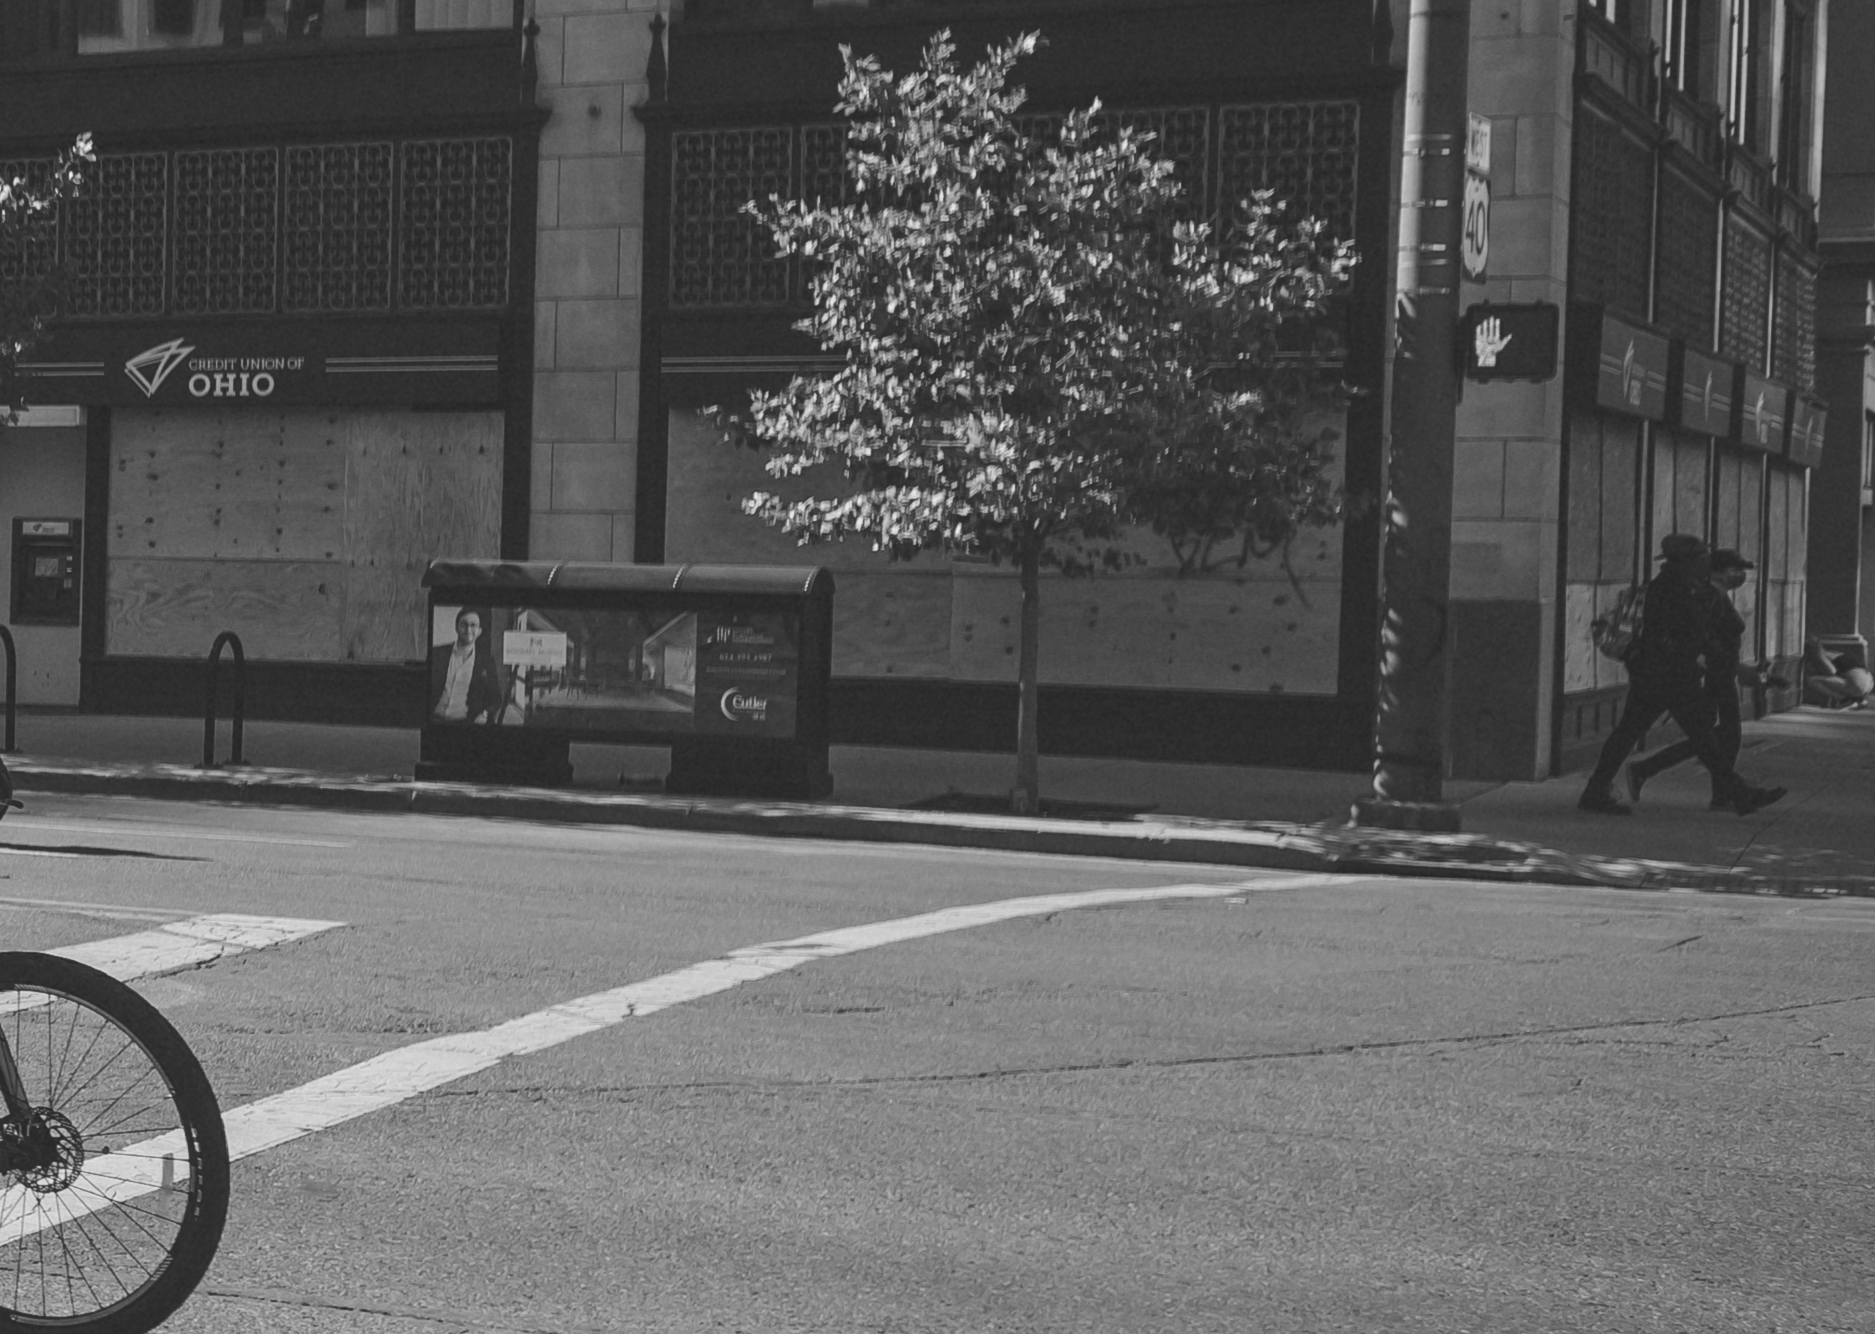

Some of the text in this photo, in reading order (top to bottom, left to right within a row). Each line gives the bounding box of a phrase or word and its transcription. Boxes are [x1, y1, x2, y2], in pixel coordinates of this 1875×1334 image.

[1466, 200, 1486, 255] 40
[188, 356, 305, 372] CREDIT UNION OF
[188, 371, 275, 398] OHIO
